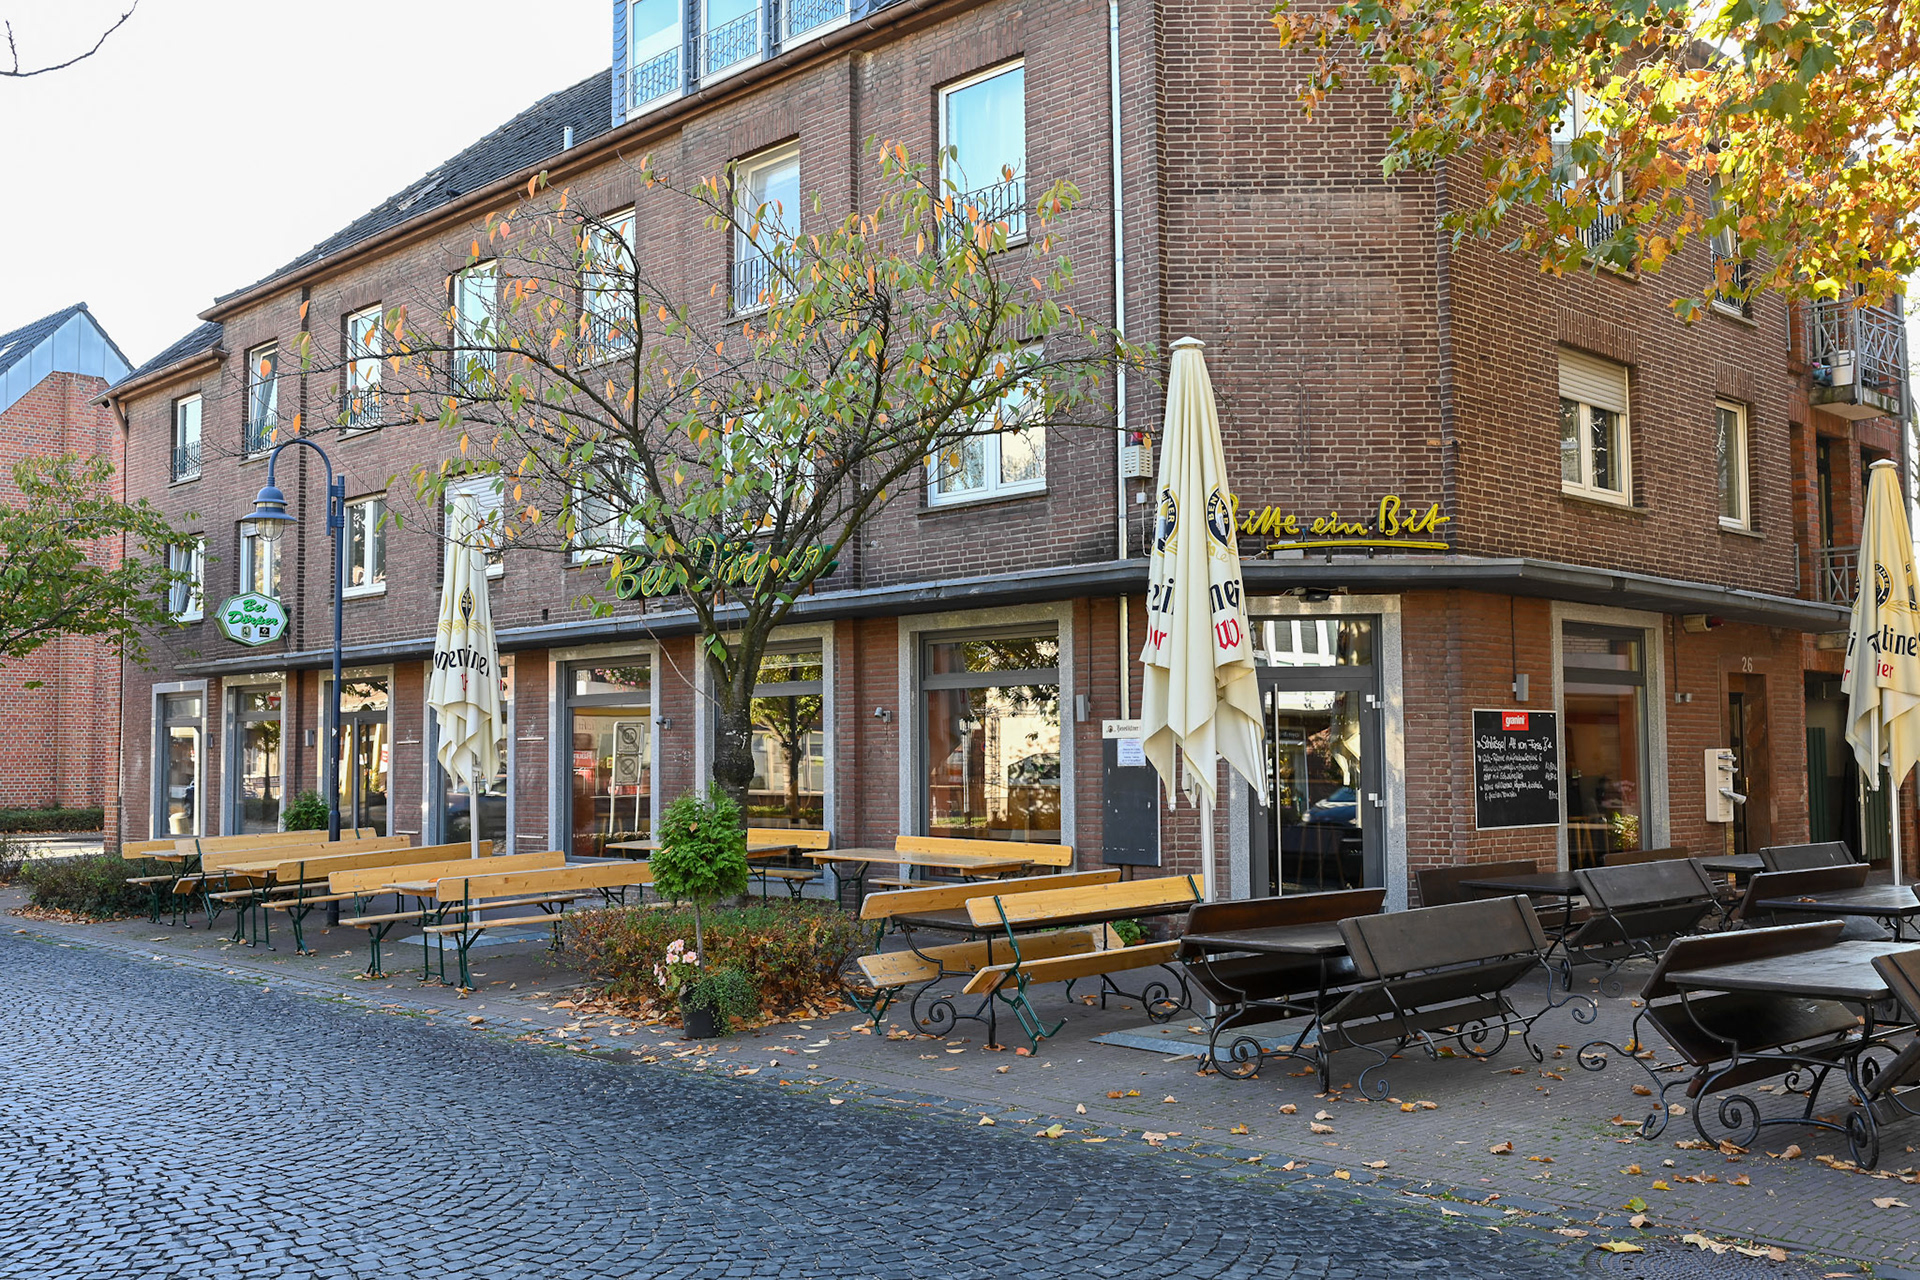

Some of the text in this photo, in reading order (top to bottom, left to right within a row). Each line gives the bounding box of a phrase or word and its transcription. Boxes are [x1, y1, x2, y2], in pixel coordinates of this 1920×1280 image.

[1310, 511, 1368, 536] ein
[1378, 495, 1450, 537] Bit
[243, 599, 268, 613] Bei
[228, 611, 278, 629] Dörper
[1742, 656, 1753, 672] 26
[1505, 715, 1525, 728] granini
